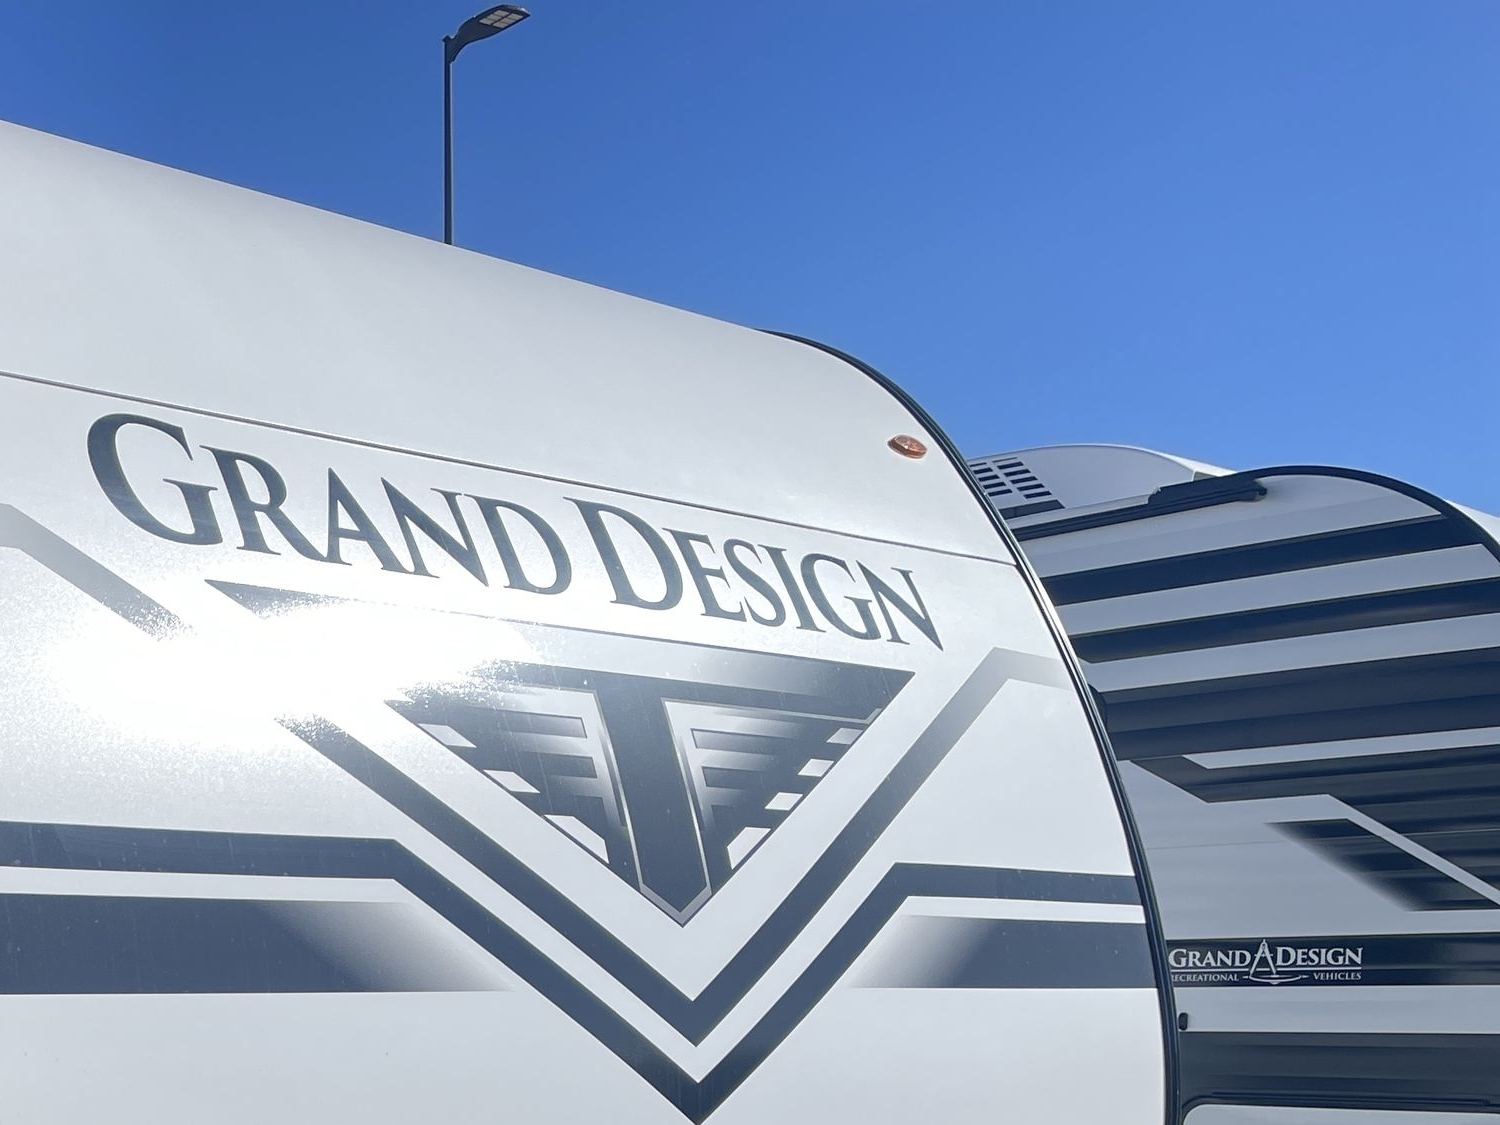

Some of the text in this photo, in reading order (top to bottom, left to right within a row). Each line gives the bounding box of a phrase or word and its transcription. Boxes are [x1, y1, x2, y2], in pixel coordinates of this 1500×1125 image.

[87, 412, 944, 651] GRAND DESIGN
[1167, 946, 1363, 968] GRAND DESIGN
[1313, 971, 1362, 982] VEHICLES
